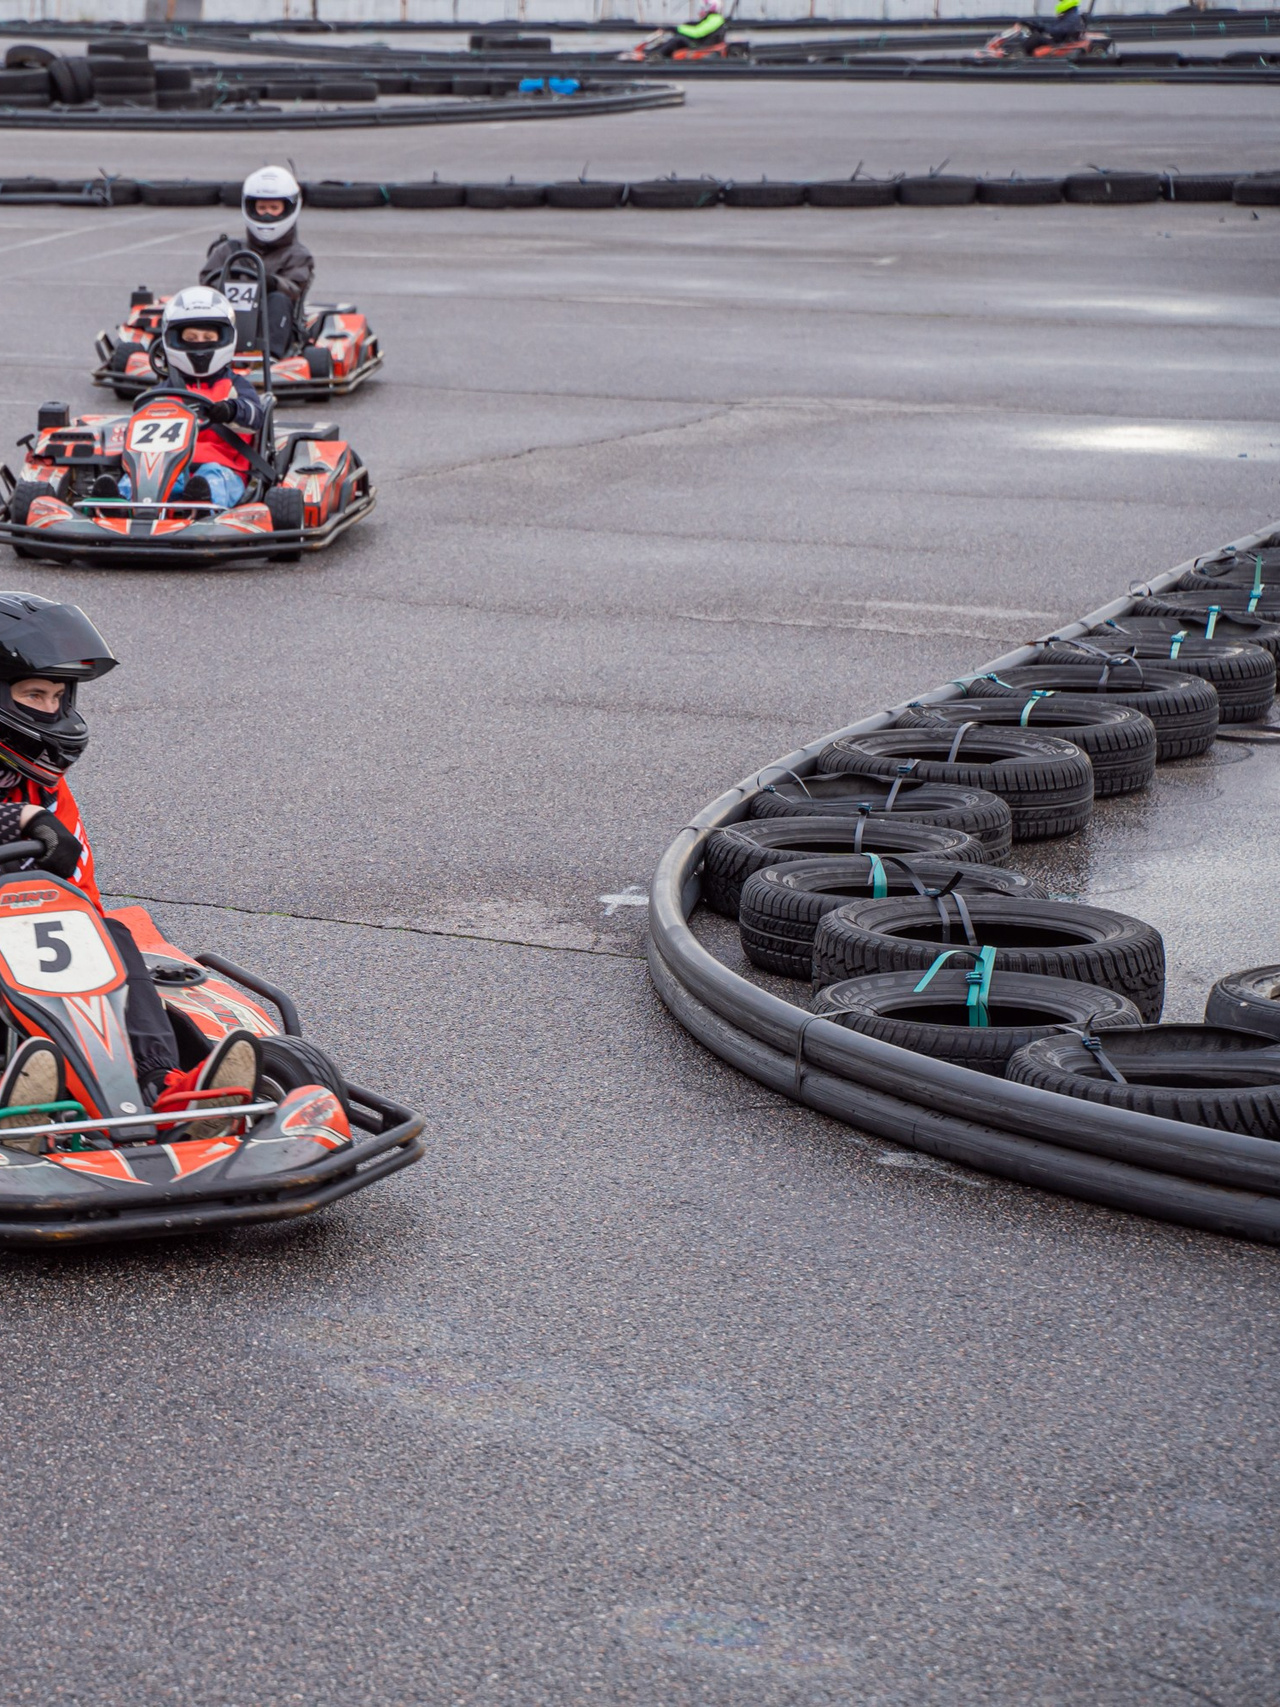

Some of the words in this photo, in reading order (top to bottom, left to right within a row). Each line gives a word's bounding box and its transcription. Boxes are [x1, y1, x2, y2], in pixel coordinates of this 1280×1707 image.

[227, 286, 255, 304] 24
[134, 422, 184, 445] 24
[0, 889, 59, 906] DINO
[33, 920, 73, 974] 5
